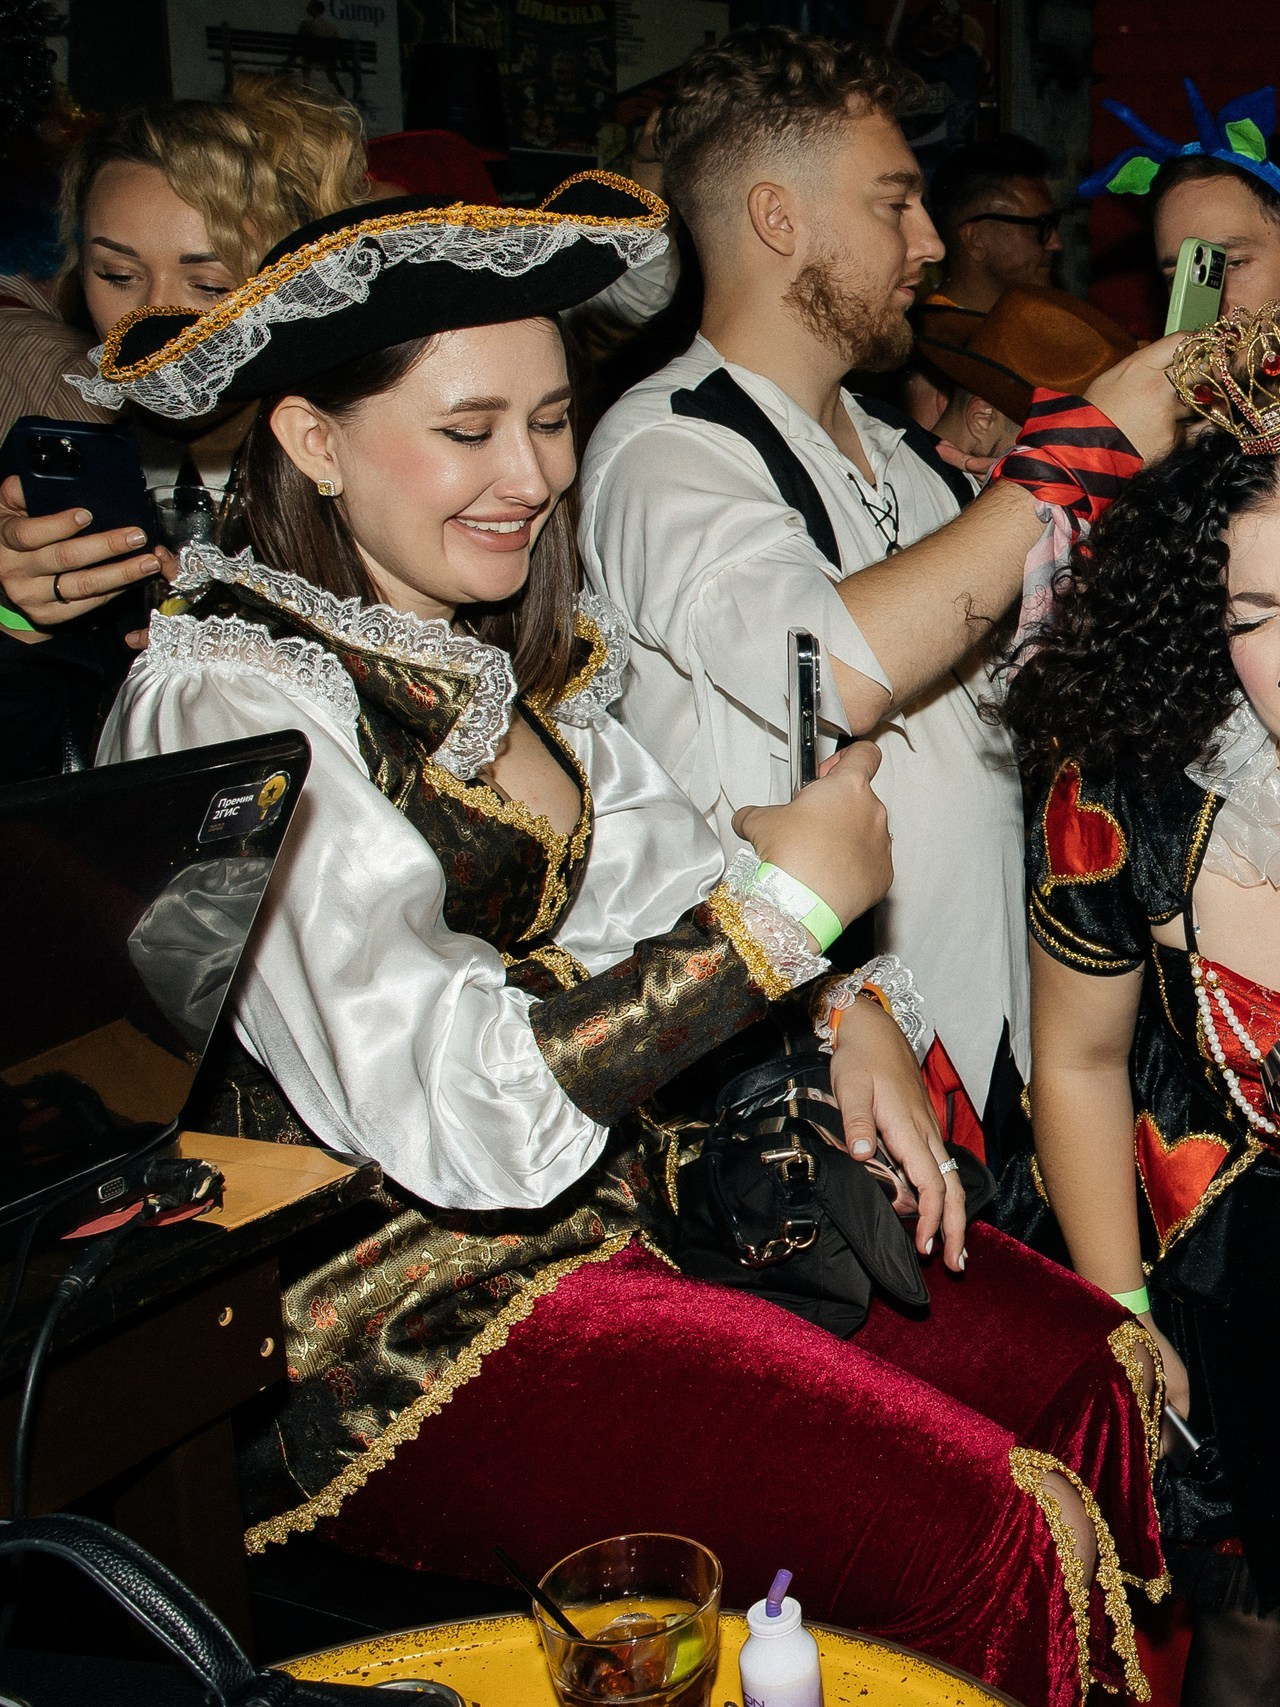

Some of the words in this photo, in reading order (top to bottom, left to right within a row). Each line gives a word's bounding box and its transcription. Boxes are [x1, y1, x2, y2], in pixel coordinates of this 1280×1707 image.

[330, 0, 385, 27] Gump
[516, 0, 606, 25] DRACULA
[217, 794, 255, 809] Премия
[212, 806, 241, 820] 2ГИС
